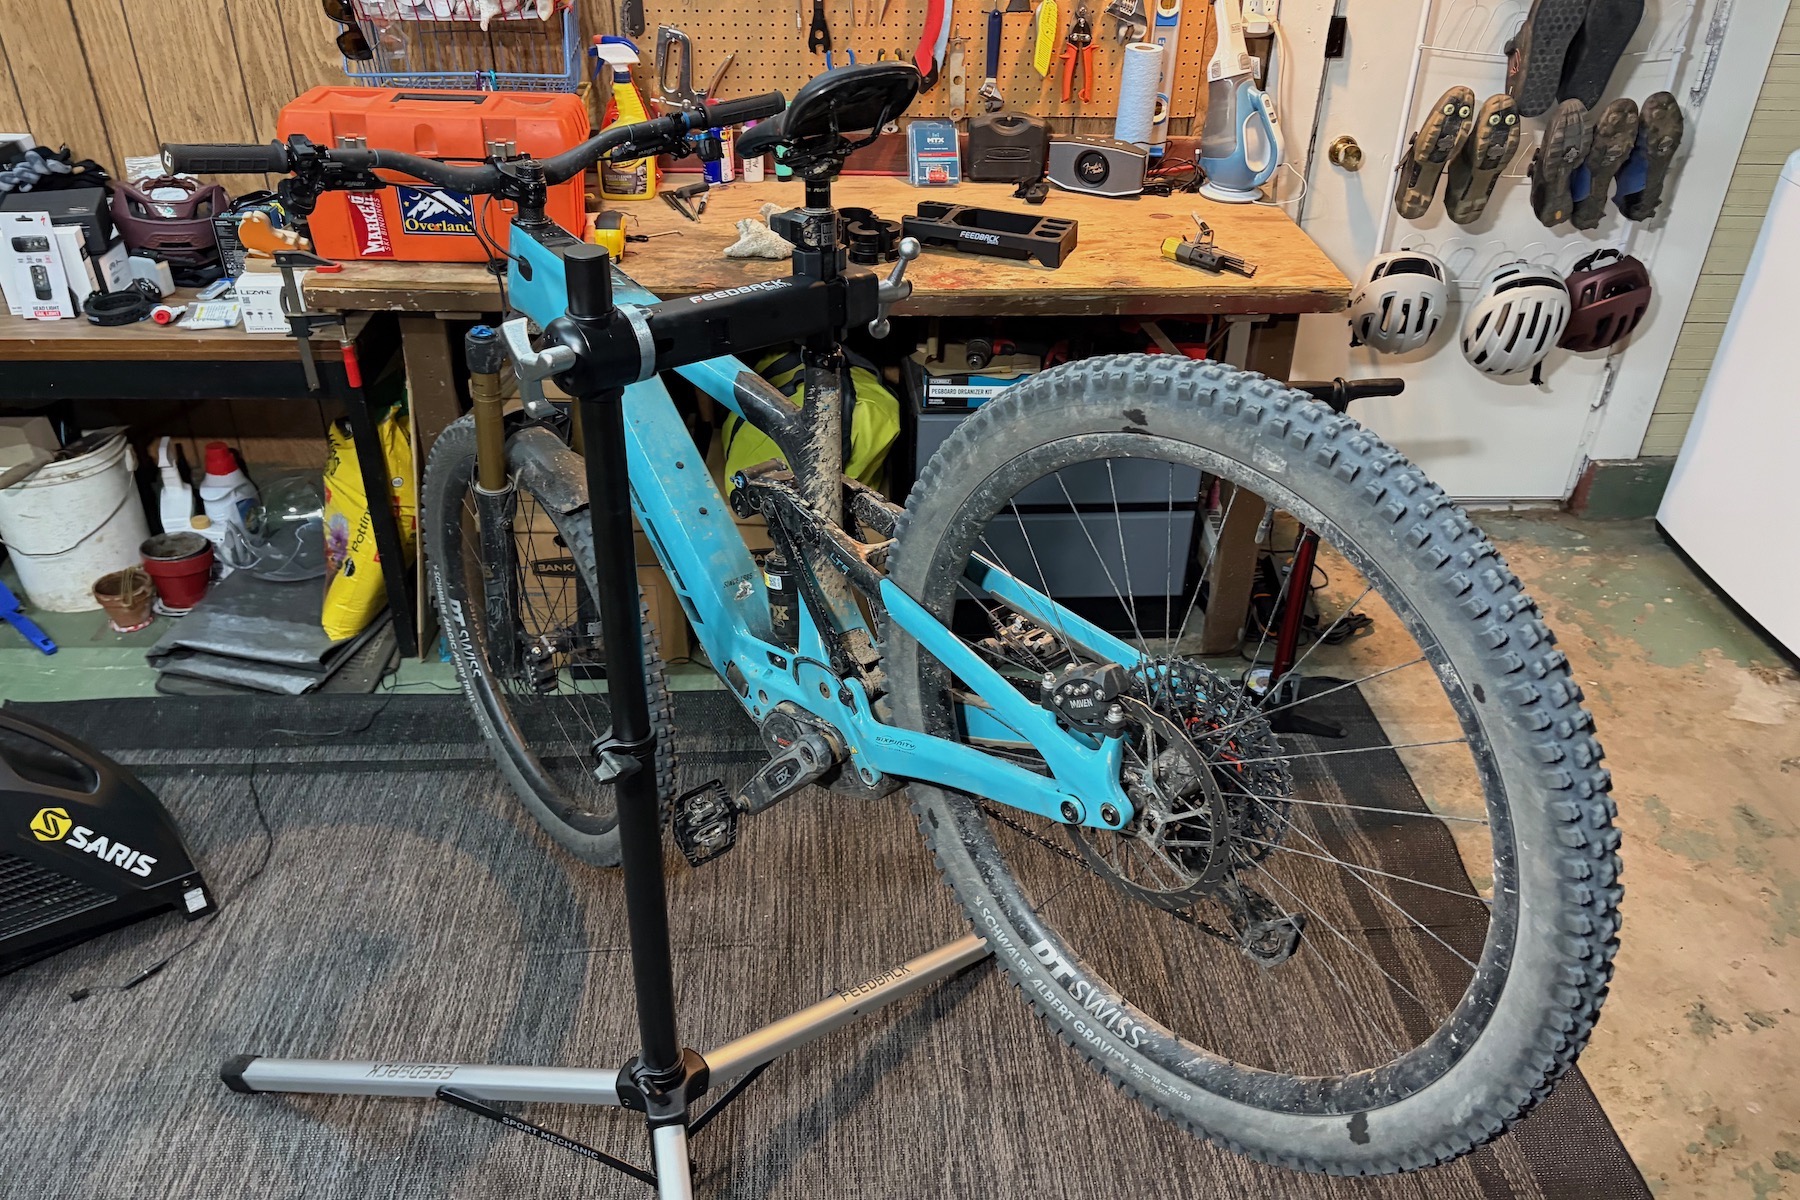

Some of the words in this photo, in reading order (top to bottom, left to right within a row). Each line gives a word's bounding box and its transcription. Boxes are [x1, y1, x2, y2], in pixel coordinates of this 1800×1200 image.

[347, 193, 386, 256] MARKER
[373, 197, 388, 236] BINDINGS
[405, 218, 473, 233] Overland
[960, 230, 1000, 243] FEEDBACK
[382, 238, 392, 252] SKI
[689, 278, 787, 304] FEEDBACK
[351, 510, 371, 553] Pottin
[443, 615, 457, 650] MAGIC
[452, 650, 467, 680] MARY
[448, 598, 467, 627] DT
[459, 628, 482, 677] SWISS
[1069, 698, 1094, 709] MAVEN
[65, 825, 158, 878] SARIS
[839, 963, 911, 1003] FEEDBACK
[979, 906, 1034, 978] SCHWALBE
[1031, 978, 1076, 1022] ALBERT
[1072, 1019, 1130, 1067] GRAVITY
[1130, 1062, 1145, 1075] PRO
[1029, 939, 1078, 981] DT
[1067, 979, 1148, 1050] SWISS
[364, 1063, 461, 1080] FEEDBACK
[501, 1115, 540, 1136] SPORT
[539, 1130, 601, 1161] MECHANIC
